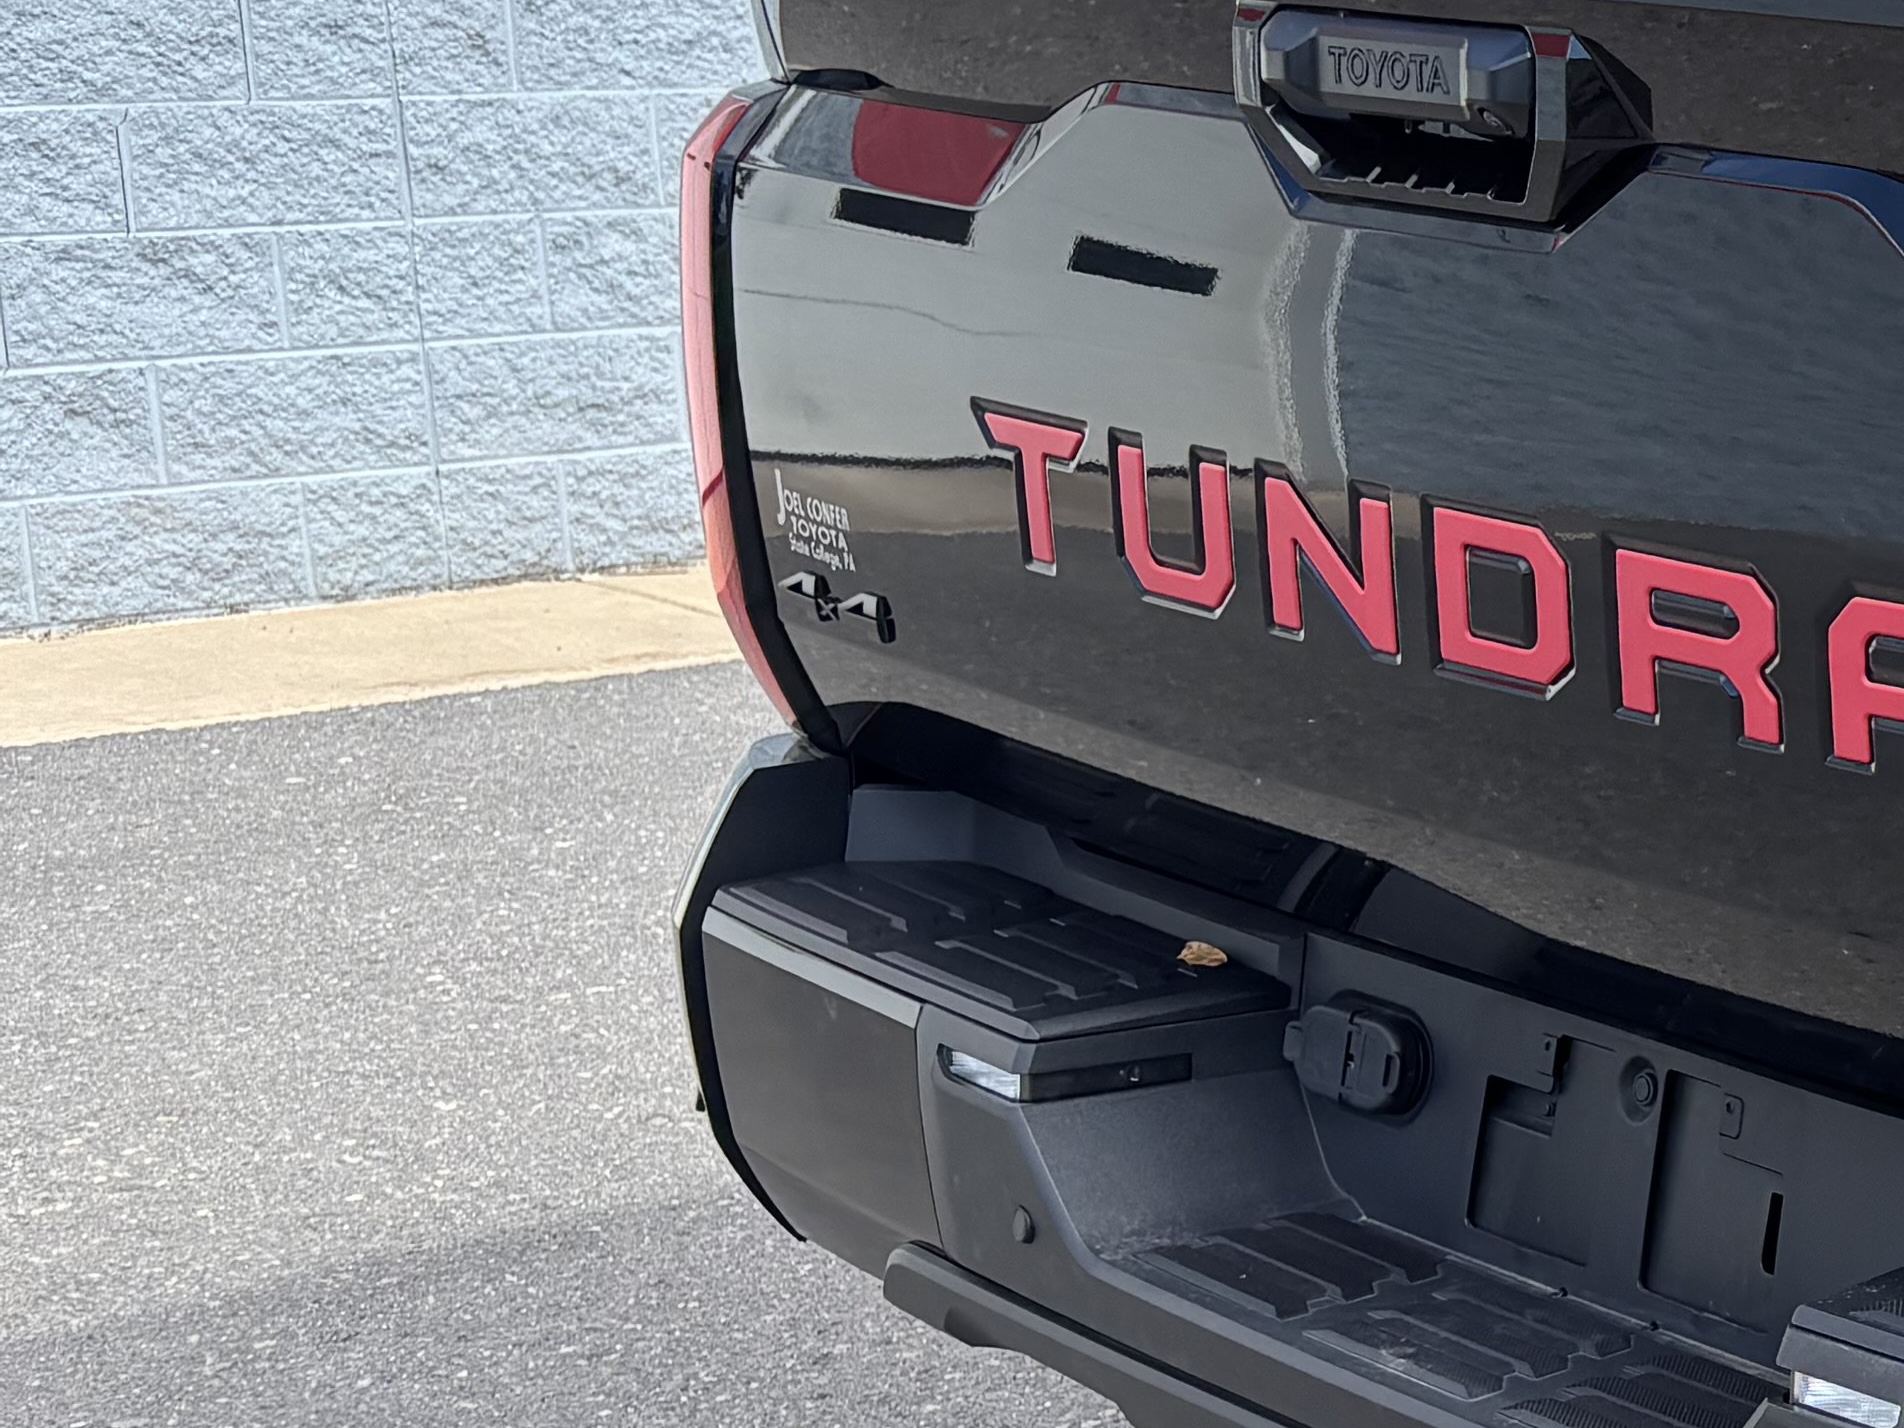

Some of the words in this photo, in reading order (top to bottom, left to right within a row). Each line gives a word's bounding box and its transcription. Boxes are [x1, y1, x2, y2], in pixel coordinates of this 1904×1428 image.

[1327, 45, 1451, 96] TOYOTA
[806, 497, 850, 532] CONFER
[790, 515, 849, 551] TOYOTA
[843, 552, 856, 572] PA
